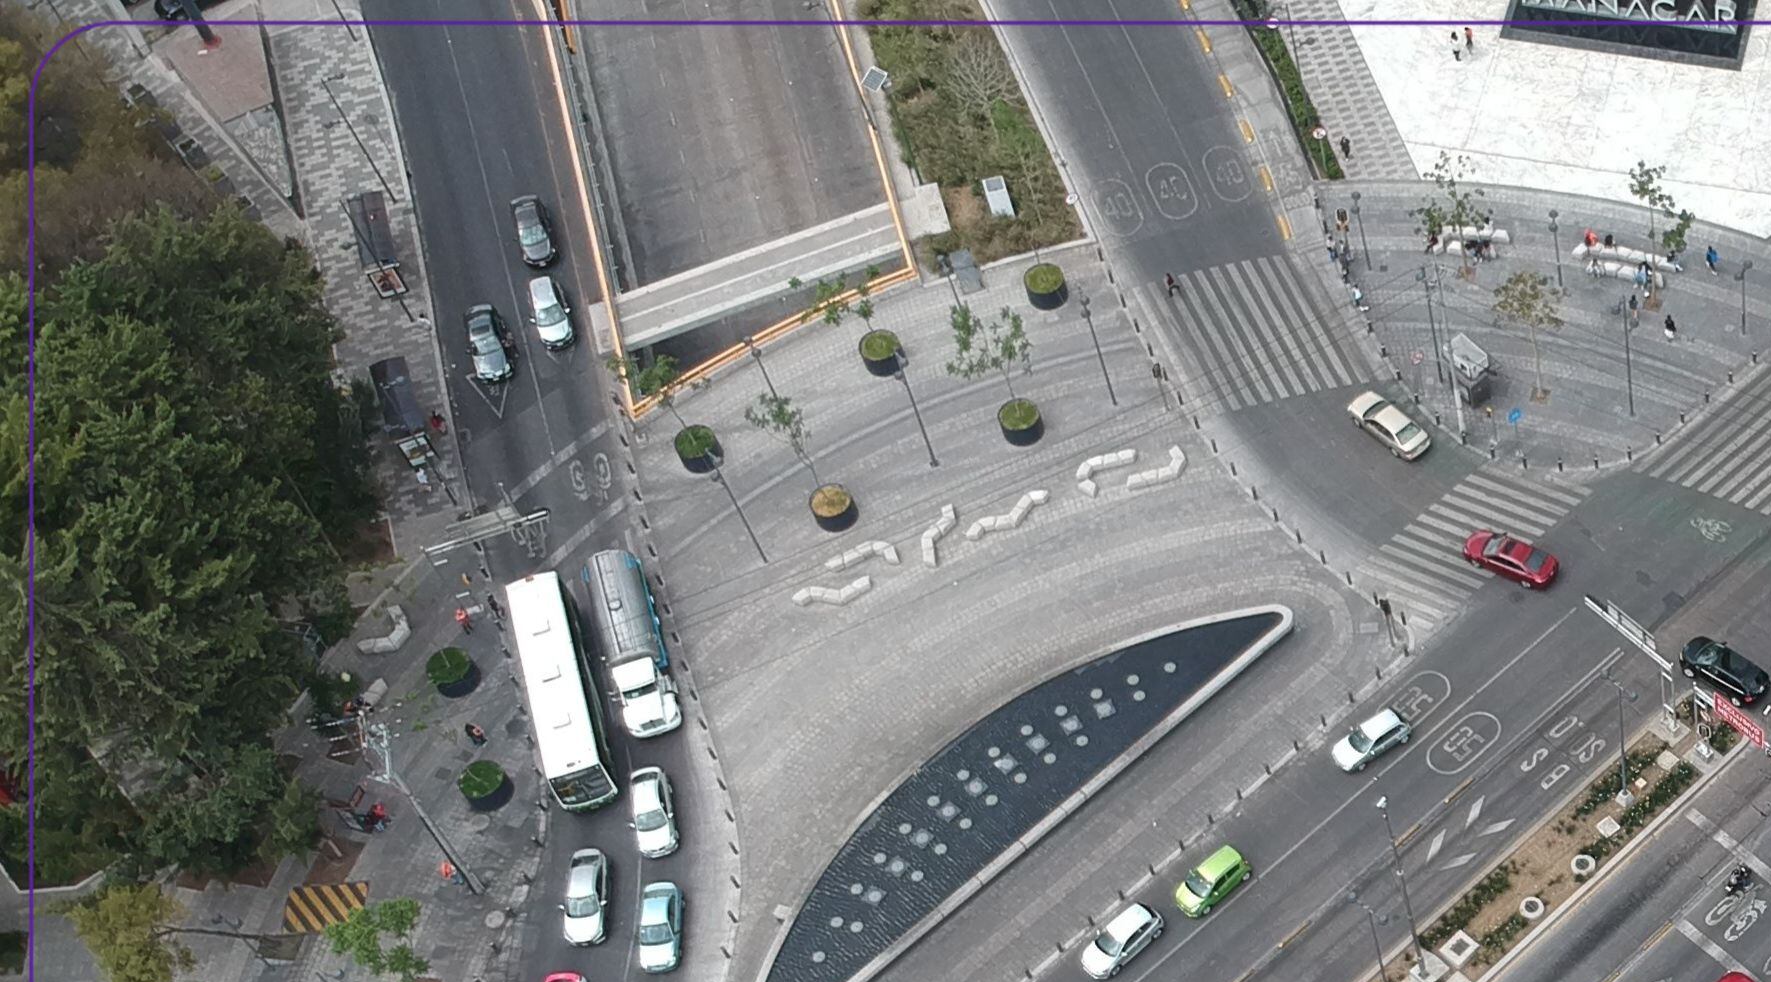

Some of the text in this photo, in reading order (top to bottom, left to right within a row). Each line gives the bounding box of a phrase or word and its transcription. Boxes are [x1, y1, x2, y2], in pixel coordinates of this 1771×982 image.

[1521, 0, 1737, 34] NACAR
[1443, 726, 1486, 762] 50
[1521, 748, 1570, 790] BS
